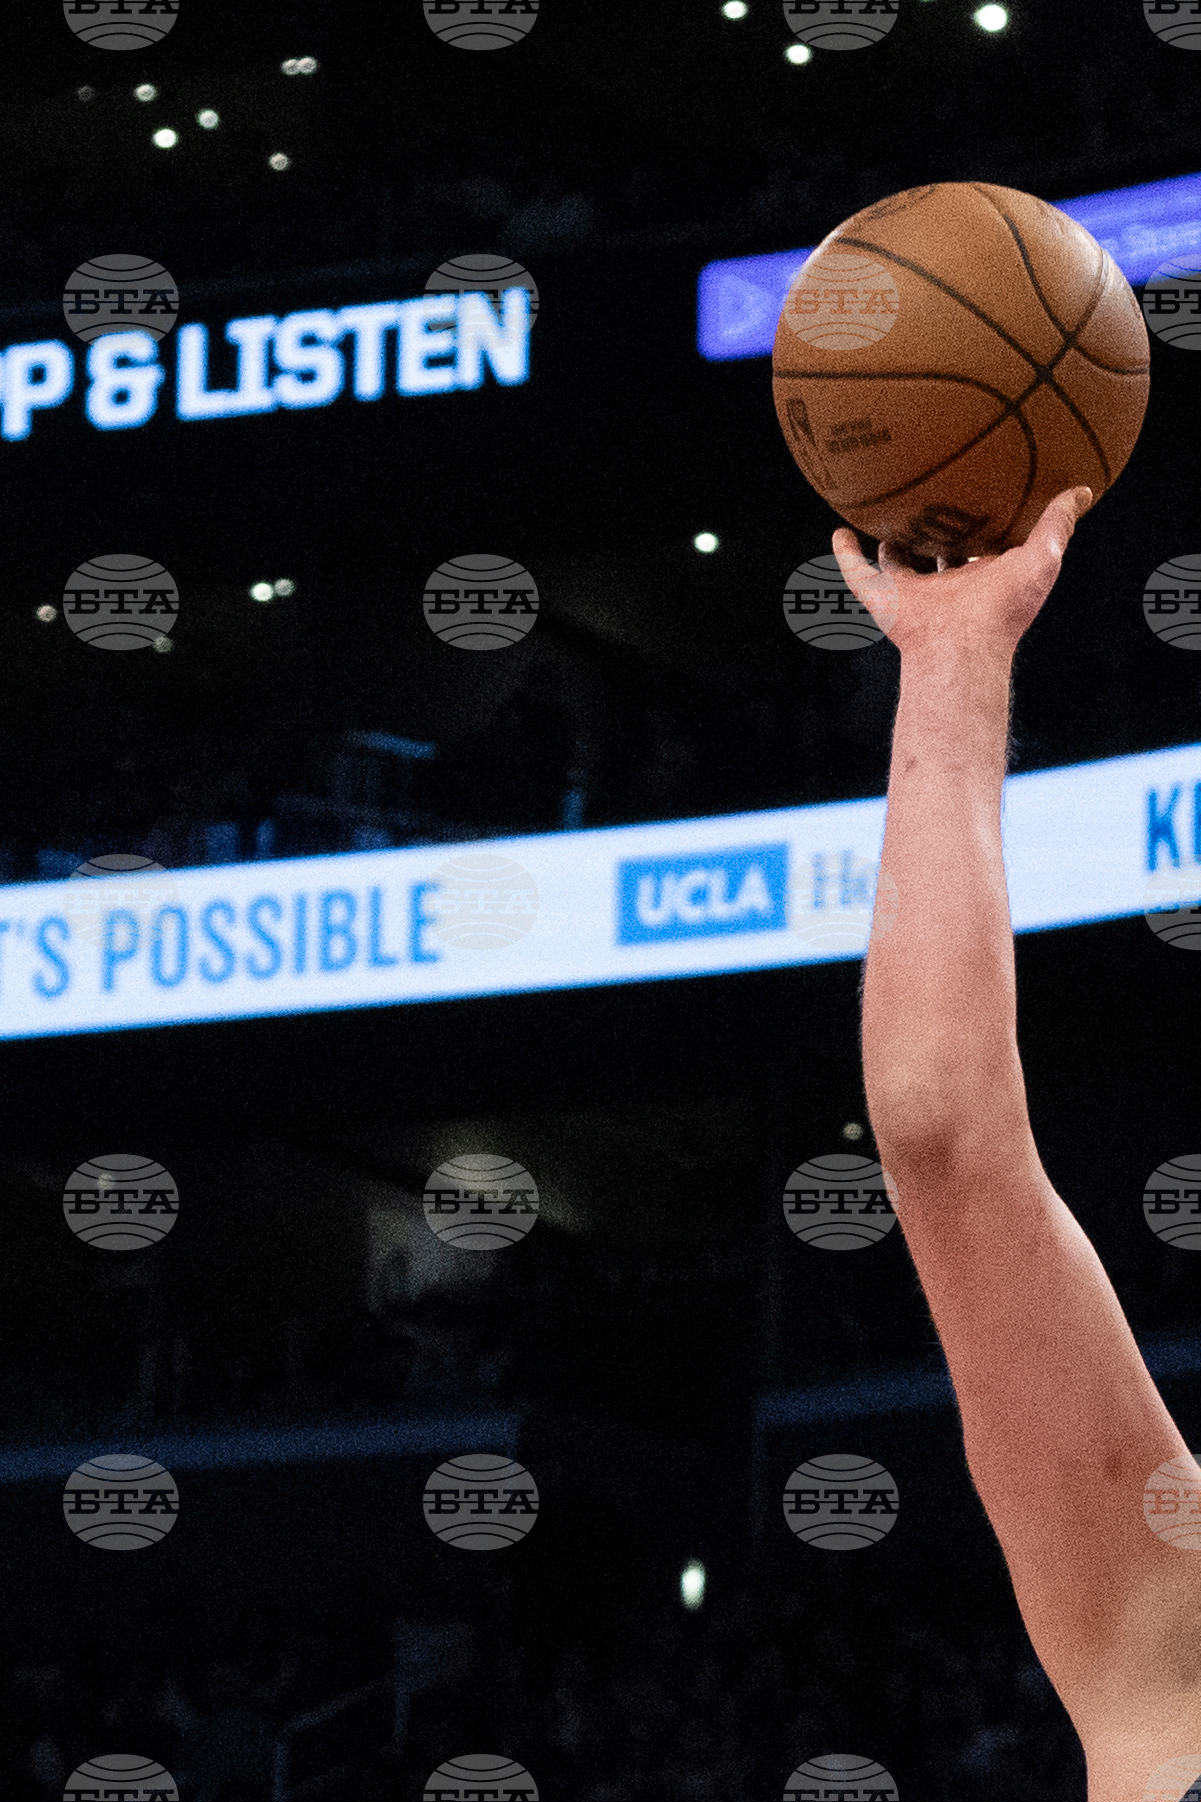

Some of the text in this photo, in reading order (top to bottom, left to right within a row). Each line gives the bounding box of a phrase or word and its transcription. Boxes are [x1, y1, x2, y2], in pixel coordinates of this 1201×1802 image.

[86, 330, 165, 431] &
[176, 286, 533, 422] LISTEN
[102, 879, 443, 994] POSSIBLE
[637, 861, 773, 926] UCLA
